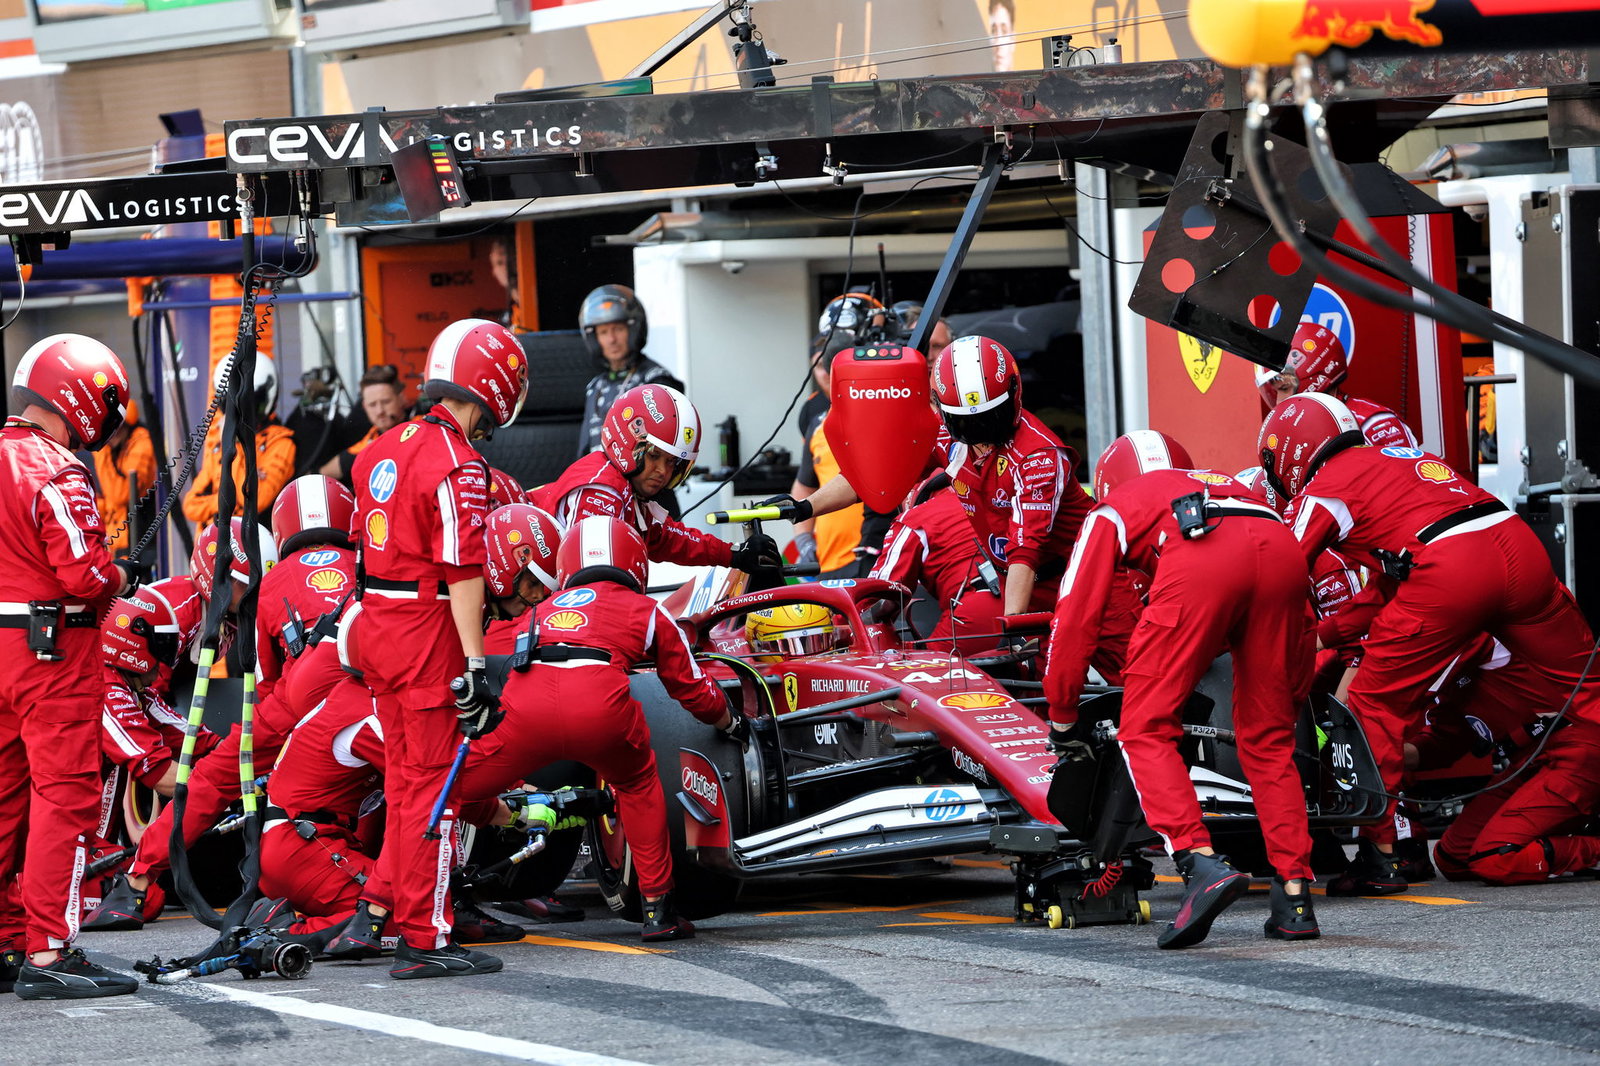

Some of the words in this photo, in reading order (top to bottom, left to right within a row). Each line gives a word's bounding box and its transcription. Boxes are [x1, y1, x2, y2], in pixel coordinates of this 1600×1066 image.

[409, 125, 582, 152] GISTICS
[109, 194, 246, 220] LOGISTICS
[849, 386, 911, 400] brembo
[1386, 447, 1419, 459] hp
[1022, 457, 1054, 470] CEVA
[370, 459, 396, 502] hp
[586, 496, 616, 514] CEVA
[529, 521, 551, 558] UniCredit
[305, 550, 337, 567] hp
[561, 589, 592, 608] hp
[727, 593, 774, 607] TECHNOLOGY
[120, 651, 149, 669] CEVA
[901, 668, 984, 683] 44
[811, 679, 844, 692] RICHARD
[846, 679, 871, 693] MILLE
[974, 713, 1020, 721] aws
[982, 725, 1044, 738] IBM
[1193, 726, 1216, 735] #3/2A
[1332, 742, 1354, 769] aws
[691, 771, 718, 806] UniCredit
[926, 789, 963, 821] hp
[438, 828, 450, 884] SCUDERIA
